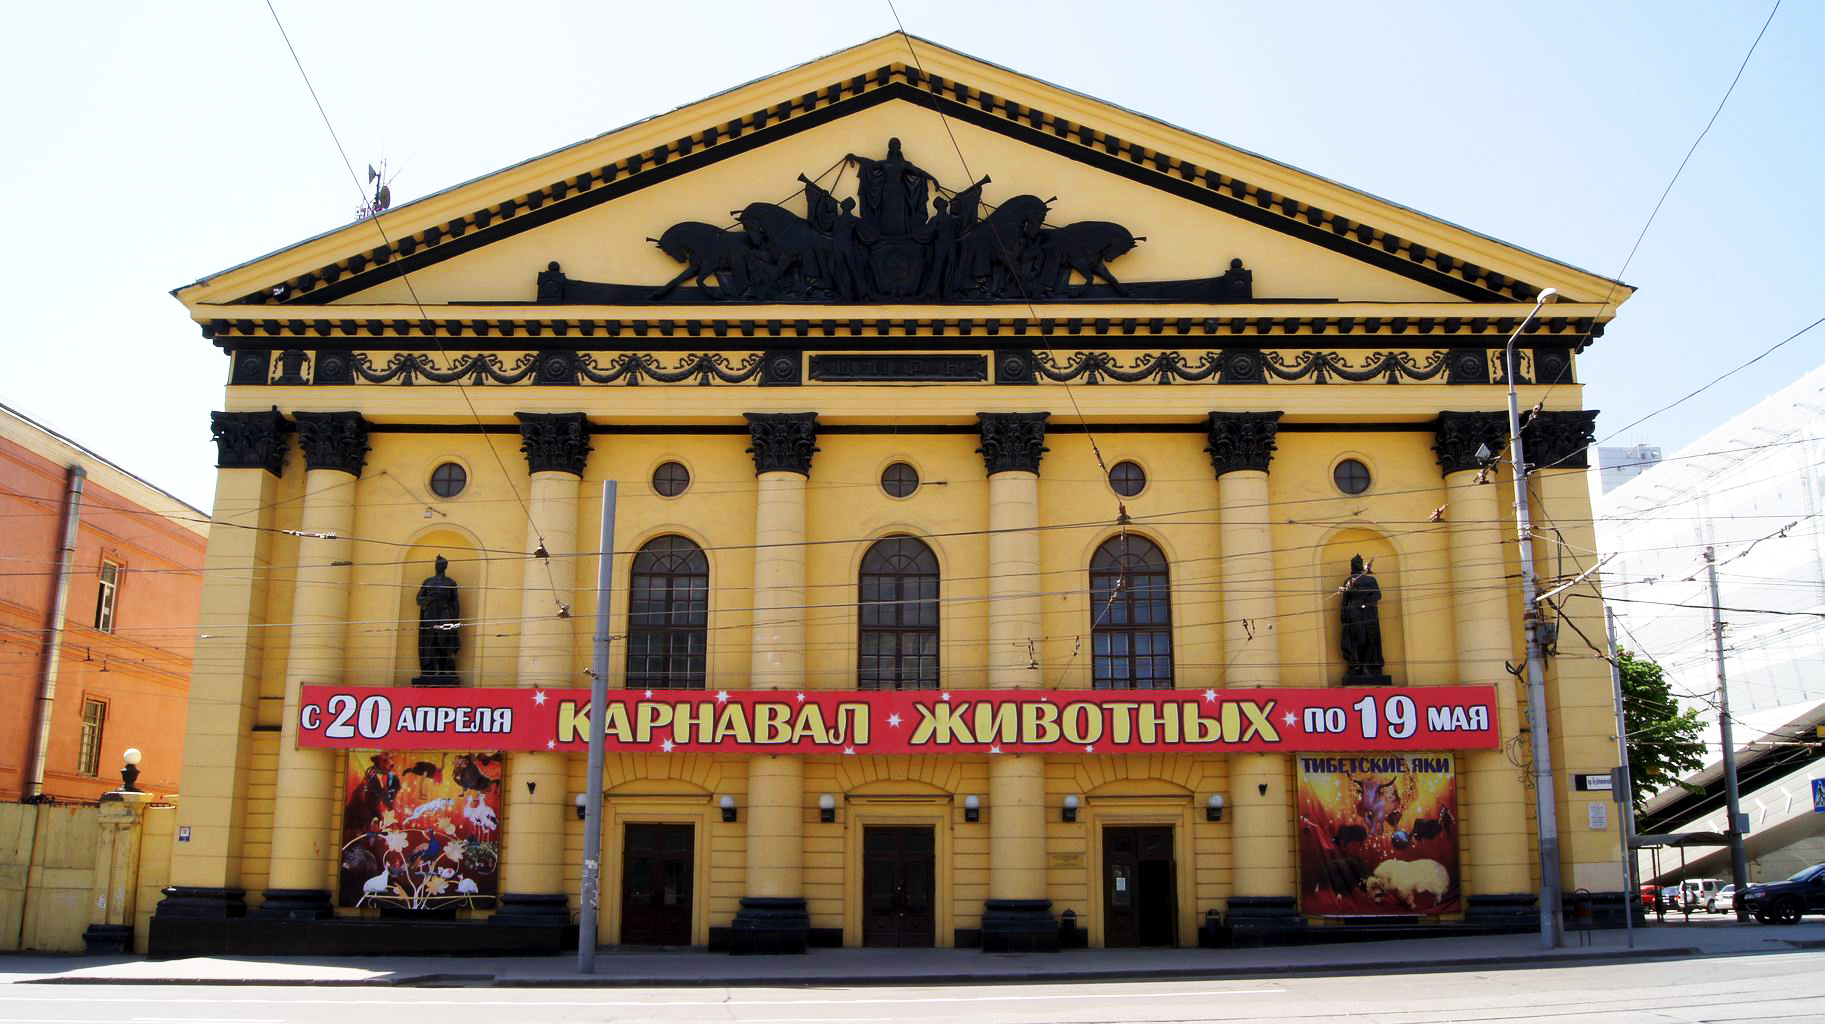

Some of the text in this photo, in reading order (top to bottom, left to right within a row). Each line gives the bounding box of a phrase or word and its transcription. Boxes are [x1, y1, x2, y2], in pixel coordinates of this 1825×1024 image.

[325, 694, 393, 739] 20
[396, 706, 513, 734] АПРЕЛЯ
[557, 701, 870, 745] КАРНАВАЛ
[908, 701, 1281, 745] ЖИВОТНЫХ
[1303, 707, 1347, 734] ПО
[1353, 695, 1418, 739] 19
[1427, 705, 1489, 732] МАЯ
[1301, 757, 1450, 774] ТИБЕТСКИЕ ЯКИ
